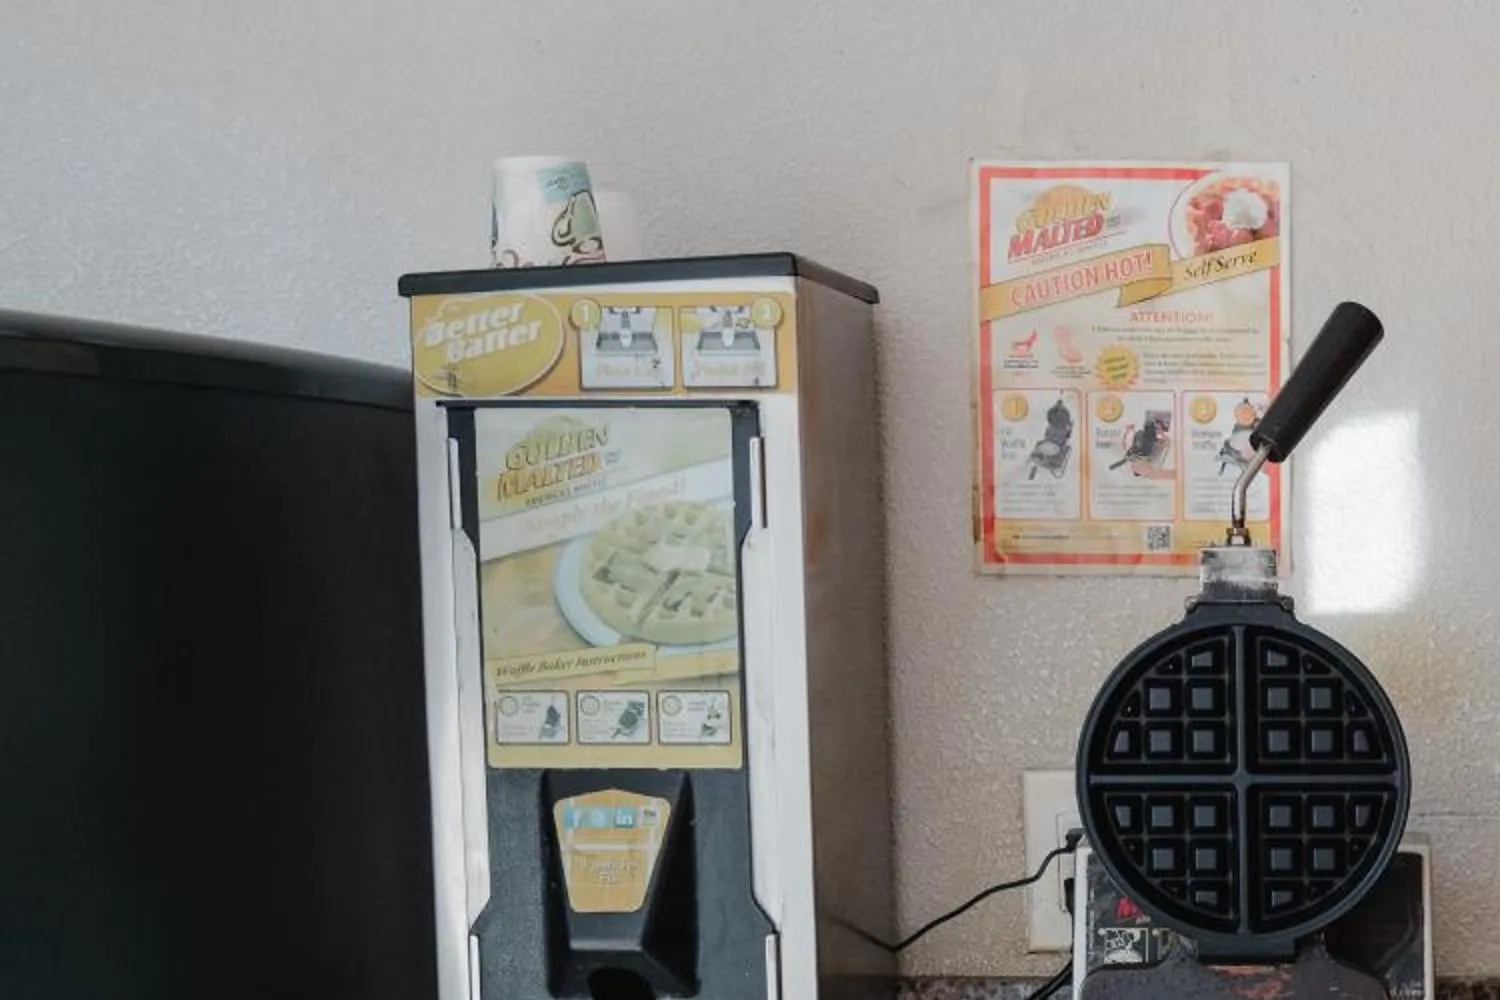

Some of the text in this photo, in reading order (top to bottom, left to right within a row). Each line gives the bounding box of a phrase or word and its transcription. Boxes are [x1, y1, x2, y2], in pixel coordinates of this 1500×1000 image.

[1008, 211, 1105, 260] MALTED
[1010, 265, 1099, 308] CAUTION
[1104, 250, 1154, 280] HOT!
[1184, 251, 1258, 280] Self Serve
[424, 301, 525, 347] Better
[1130, 311, 1214, 323] ATTENTION!
[497, 451, 600, 504] MALTED
